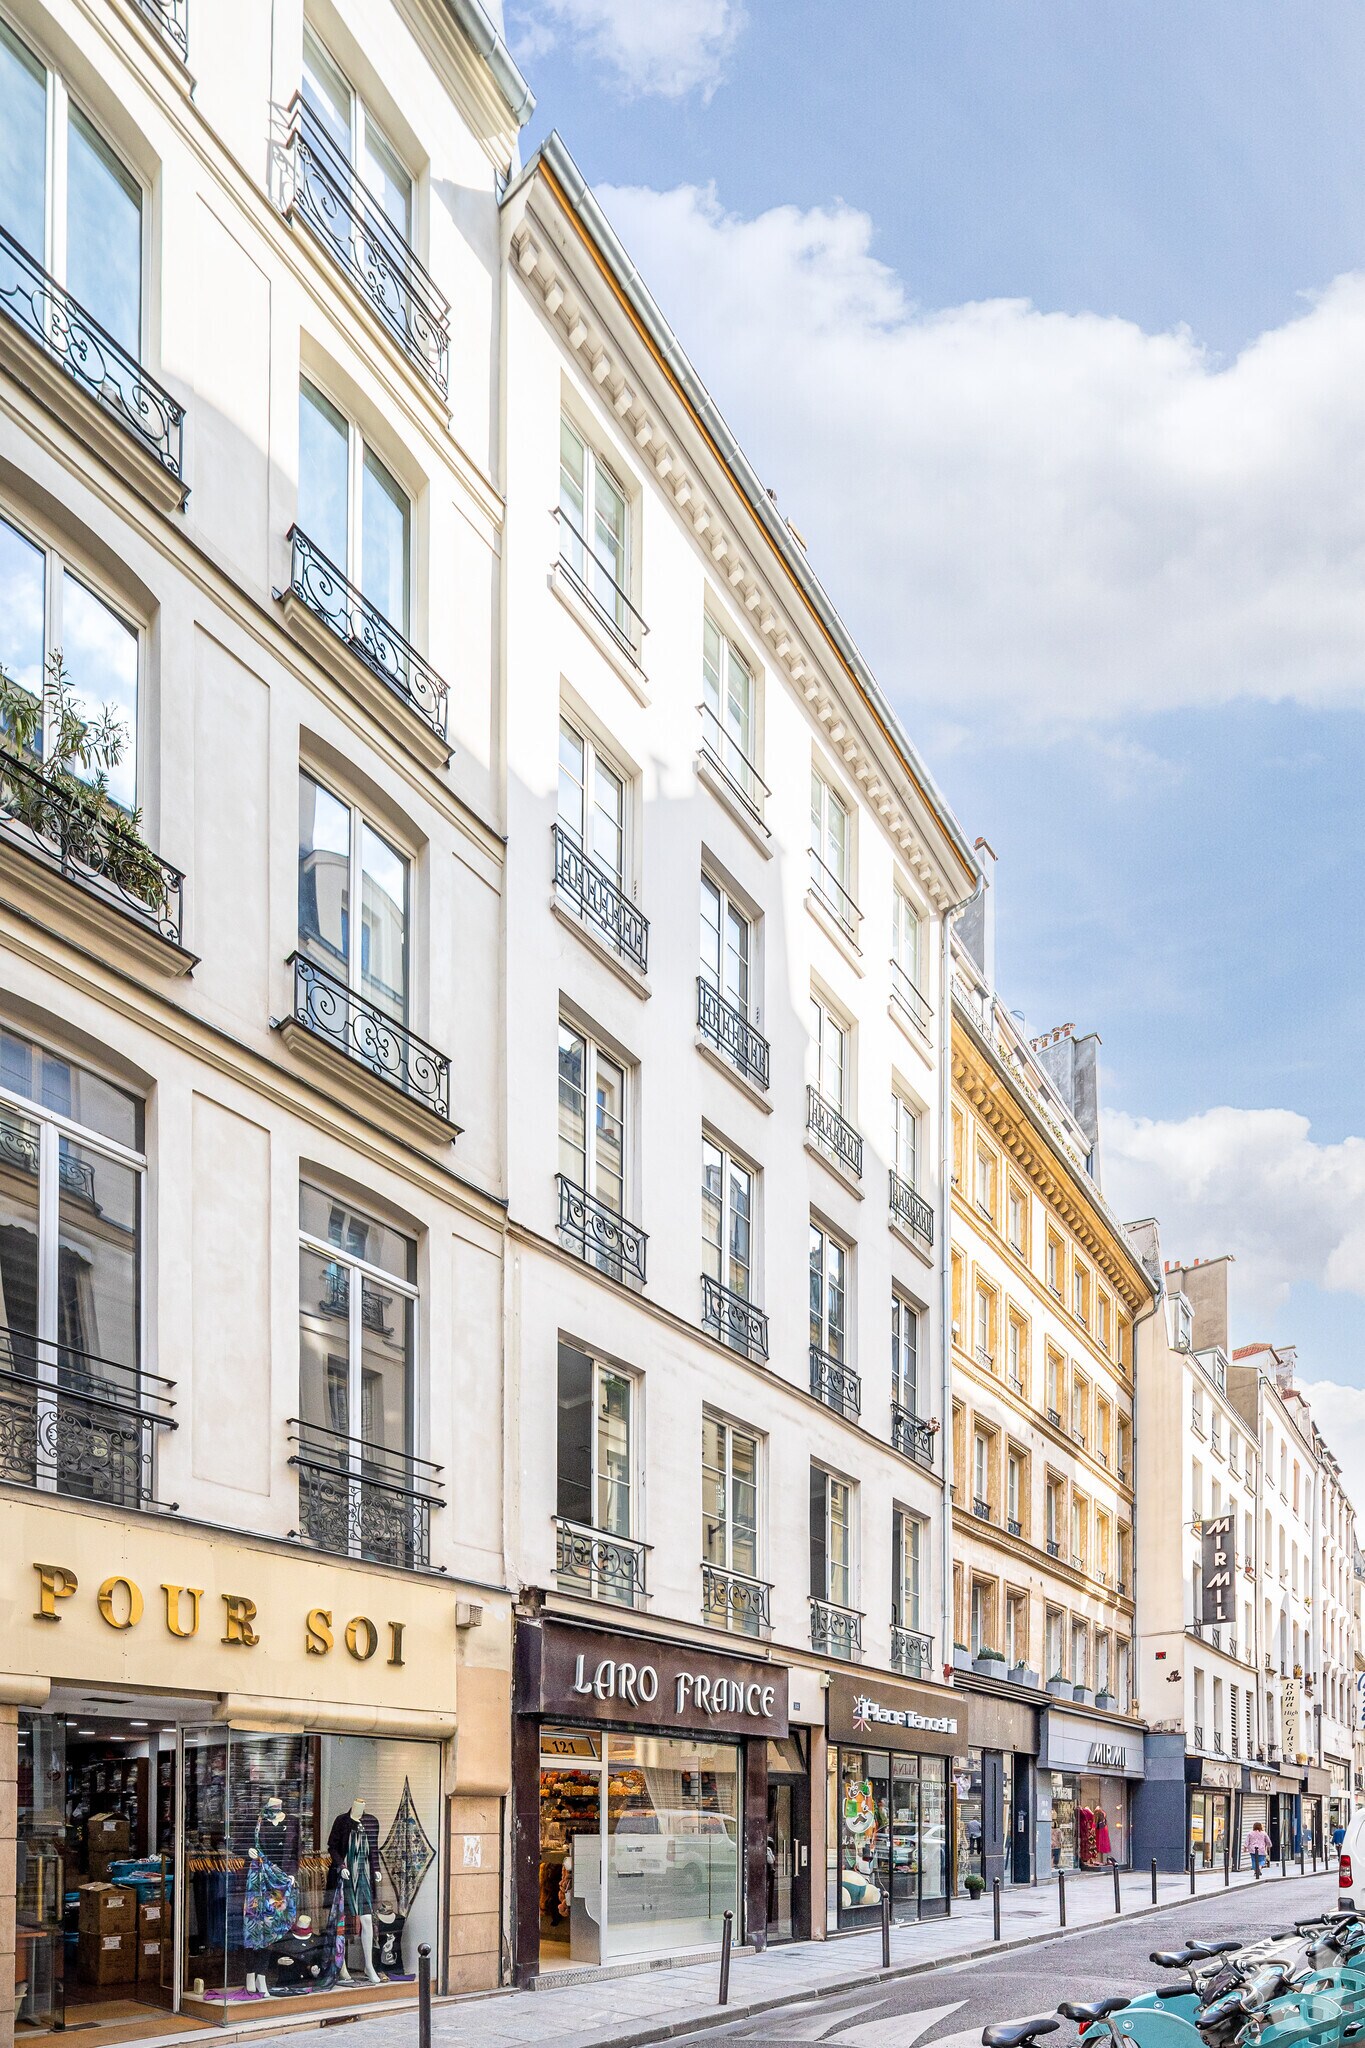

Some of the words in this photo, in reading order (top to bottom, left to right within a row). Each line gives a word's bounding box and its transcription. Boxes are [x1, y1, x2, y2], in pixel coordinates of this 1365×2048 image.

[1206, 1517, 1230, 1620] MIRMIL
[33, 1563, 260, 1647] POUR
[305, 1608, 406, 1666] SOI
[573, 1654, 659, 1708] LARO
[675, 1672, 775, 1718] FRANCE
[1285, 1683, 1294, 1707] Roma
[552, 1741, 576, 1754] 121
[1285, 1719, 1294, 1752] Class
